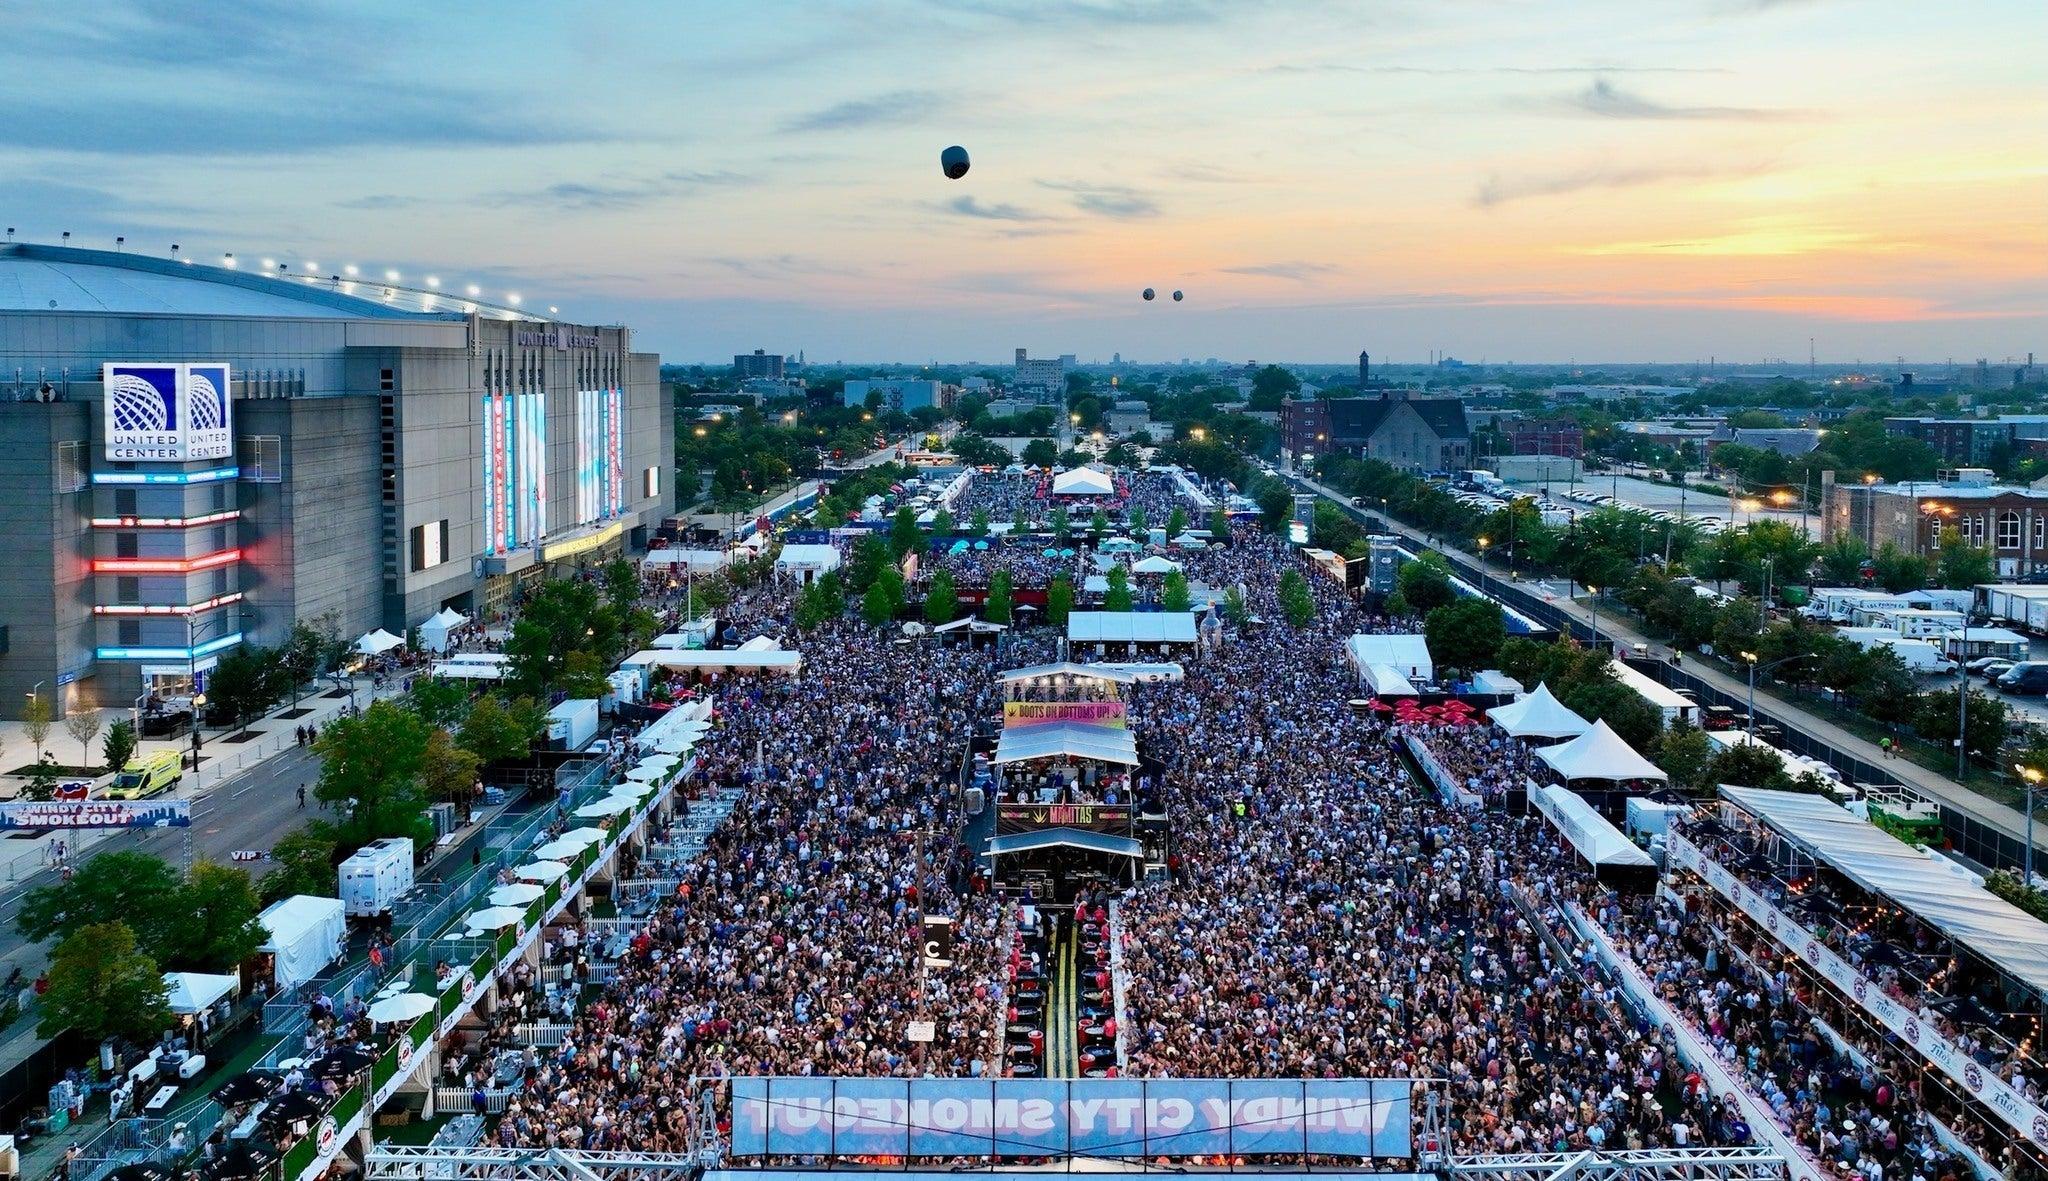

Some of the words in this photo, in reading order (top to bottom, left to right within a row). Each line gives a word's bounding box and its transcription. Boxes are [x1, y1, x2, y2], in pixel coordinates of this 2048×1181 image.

[518, 331, 557, 347] UNITED
[114, 436, 178, 445] UNITED
[190, 433, 227, 444] UNITED
[114, 448, 178, 458] CENTER
[190, 445, 227, 457] CENTER
[1019, 705, 1045, 719] BOOTS
[1045, 705, 1058, 719] ON
[1058, 705, 1096, 719] BOTTOMS
[1096, 705, 1110, 719] UP!
[24, 804, 78, 814] WINDY
[82, 803, 119, 814] CITY
[1049, 806, 1093, 824] MANITAS
[15, 813, 132, 827] SMOKEOUT
[231, 850, 257, 861] VIP
[925, 940, 940, 958] C
[1875, 999, 1896, 1020] Tito's
[1930, 1042, 1952, 1065] Tito's
[1993, 1092, 2020, 1116] Tito's
